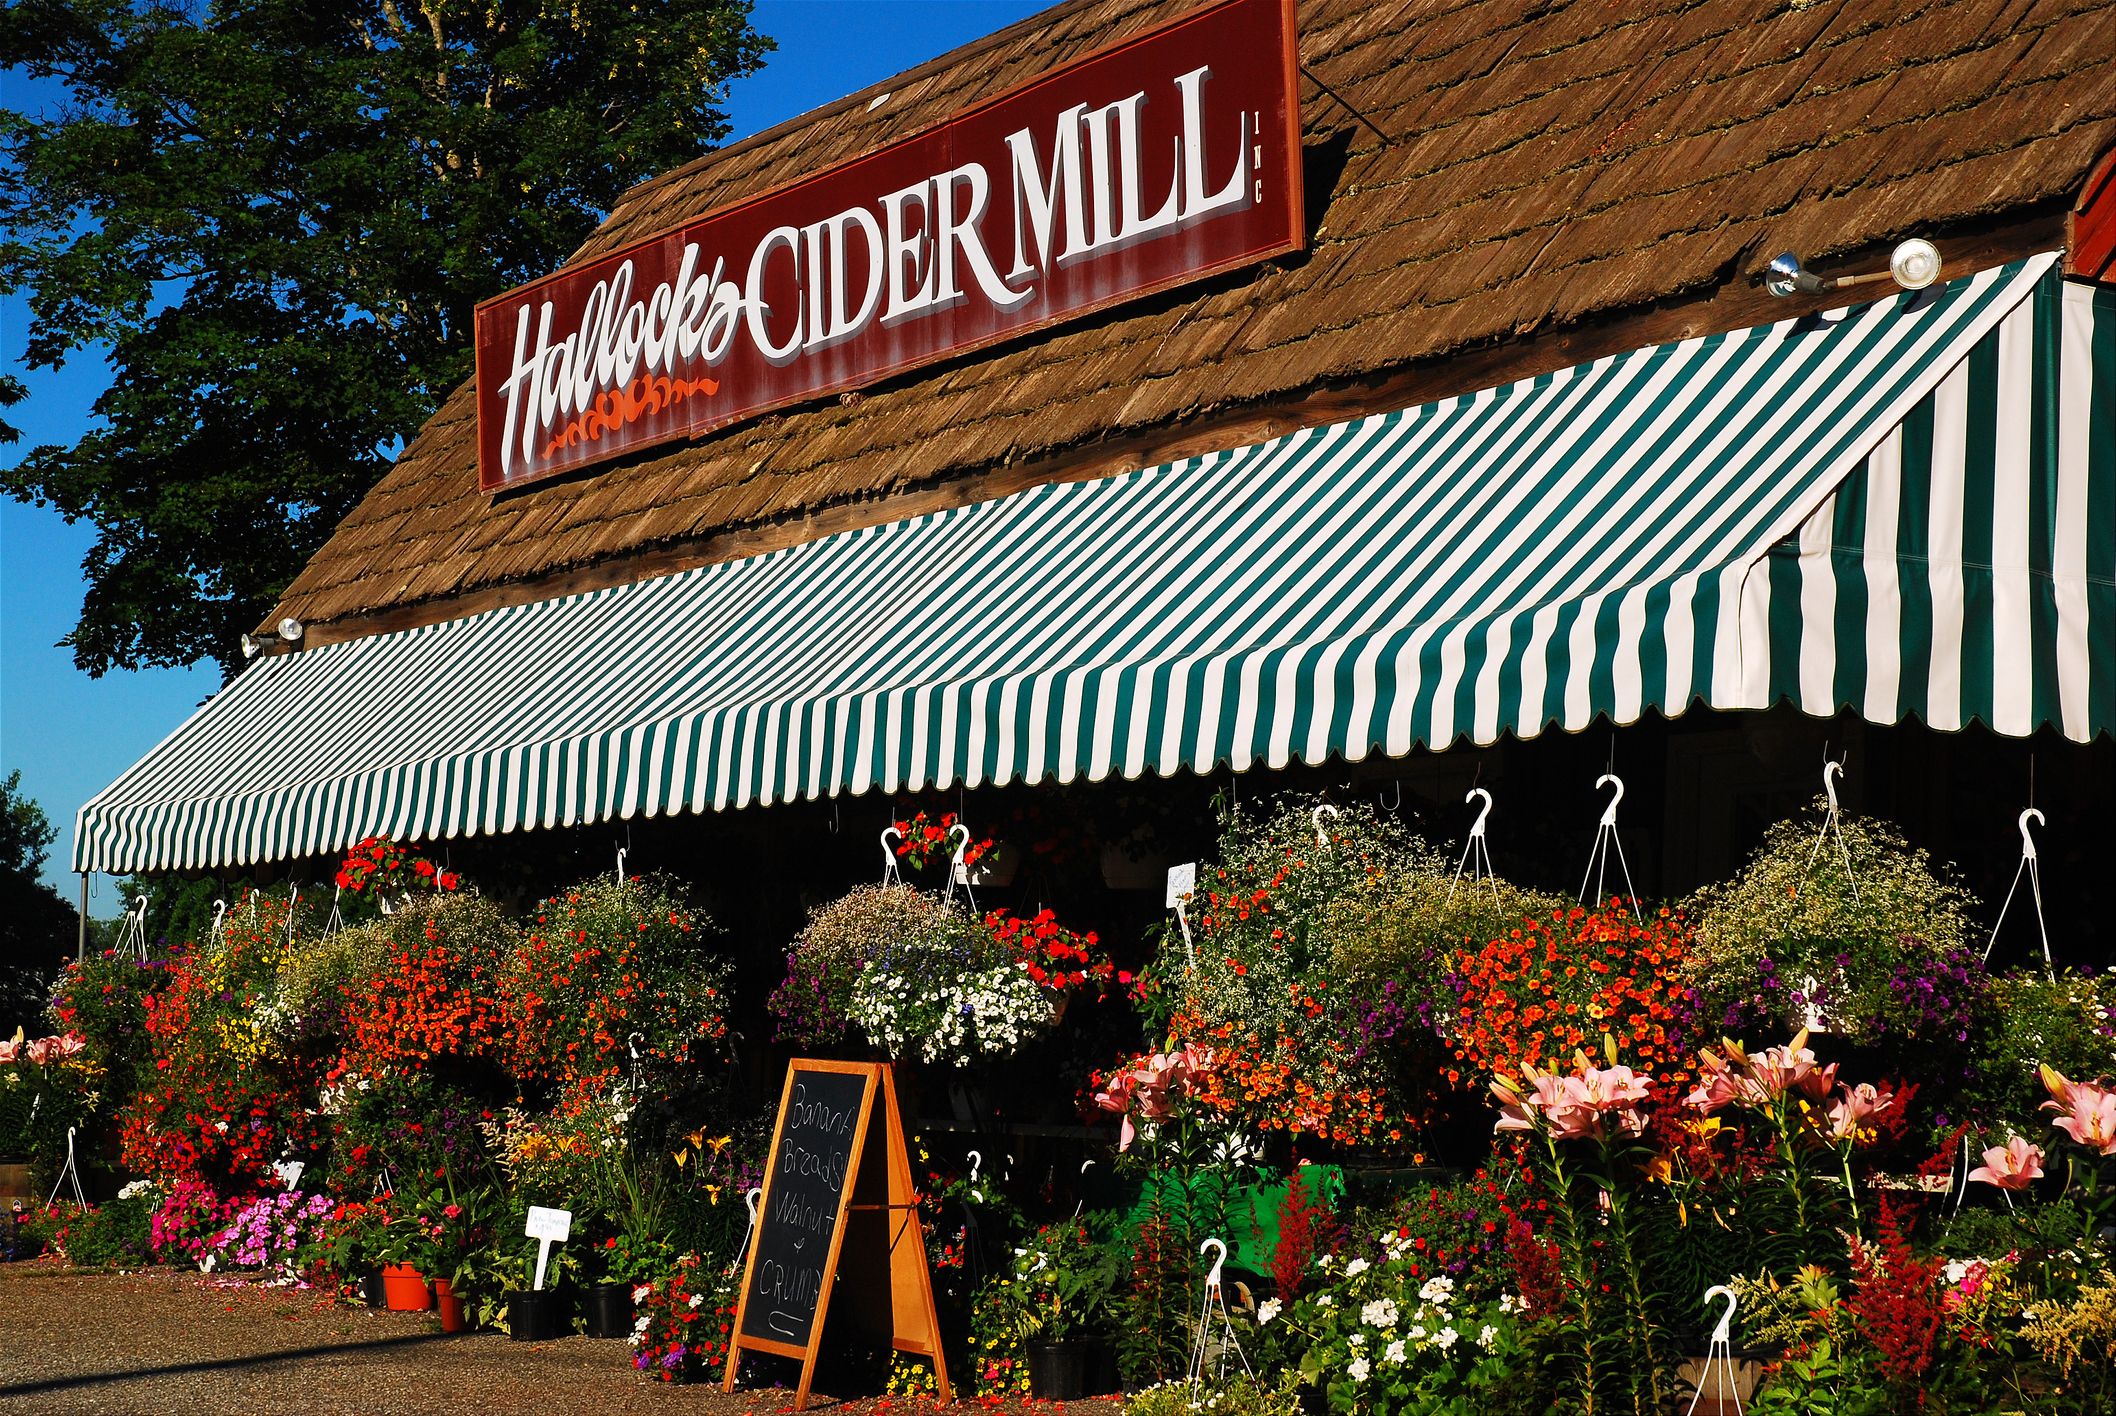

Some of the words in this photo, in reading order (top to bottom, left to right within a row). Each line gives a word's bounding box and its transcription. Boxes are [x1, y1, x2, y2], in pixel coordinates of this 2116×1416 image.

[1254, 110, 1262, 204] INC
[497, 241, 752, 476] Hallock's
[745, 162, 1034, 360] CIDER
[1004, 64, 1246, 281] MILL
[775, 1186, 835, 1236] Walnut
